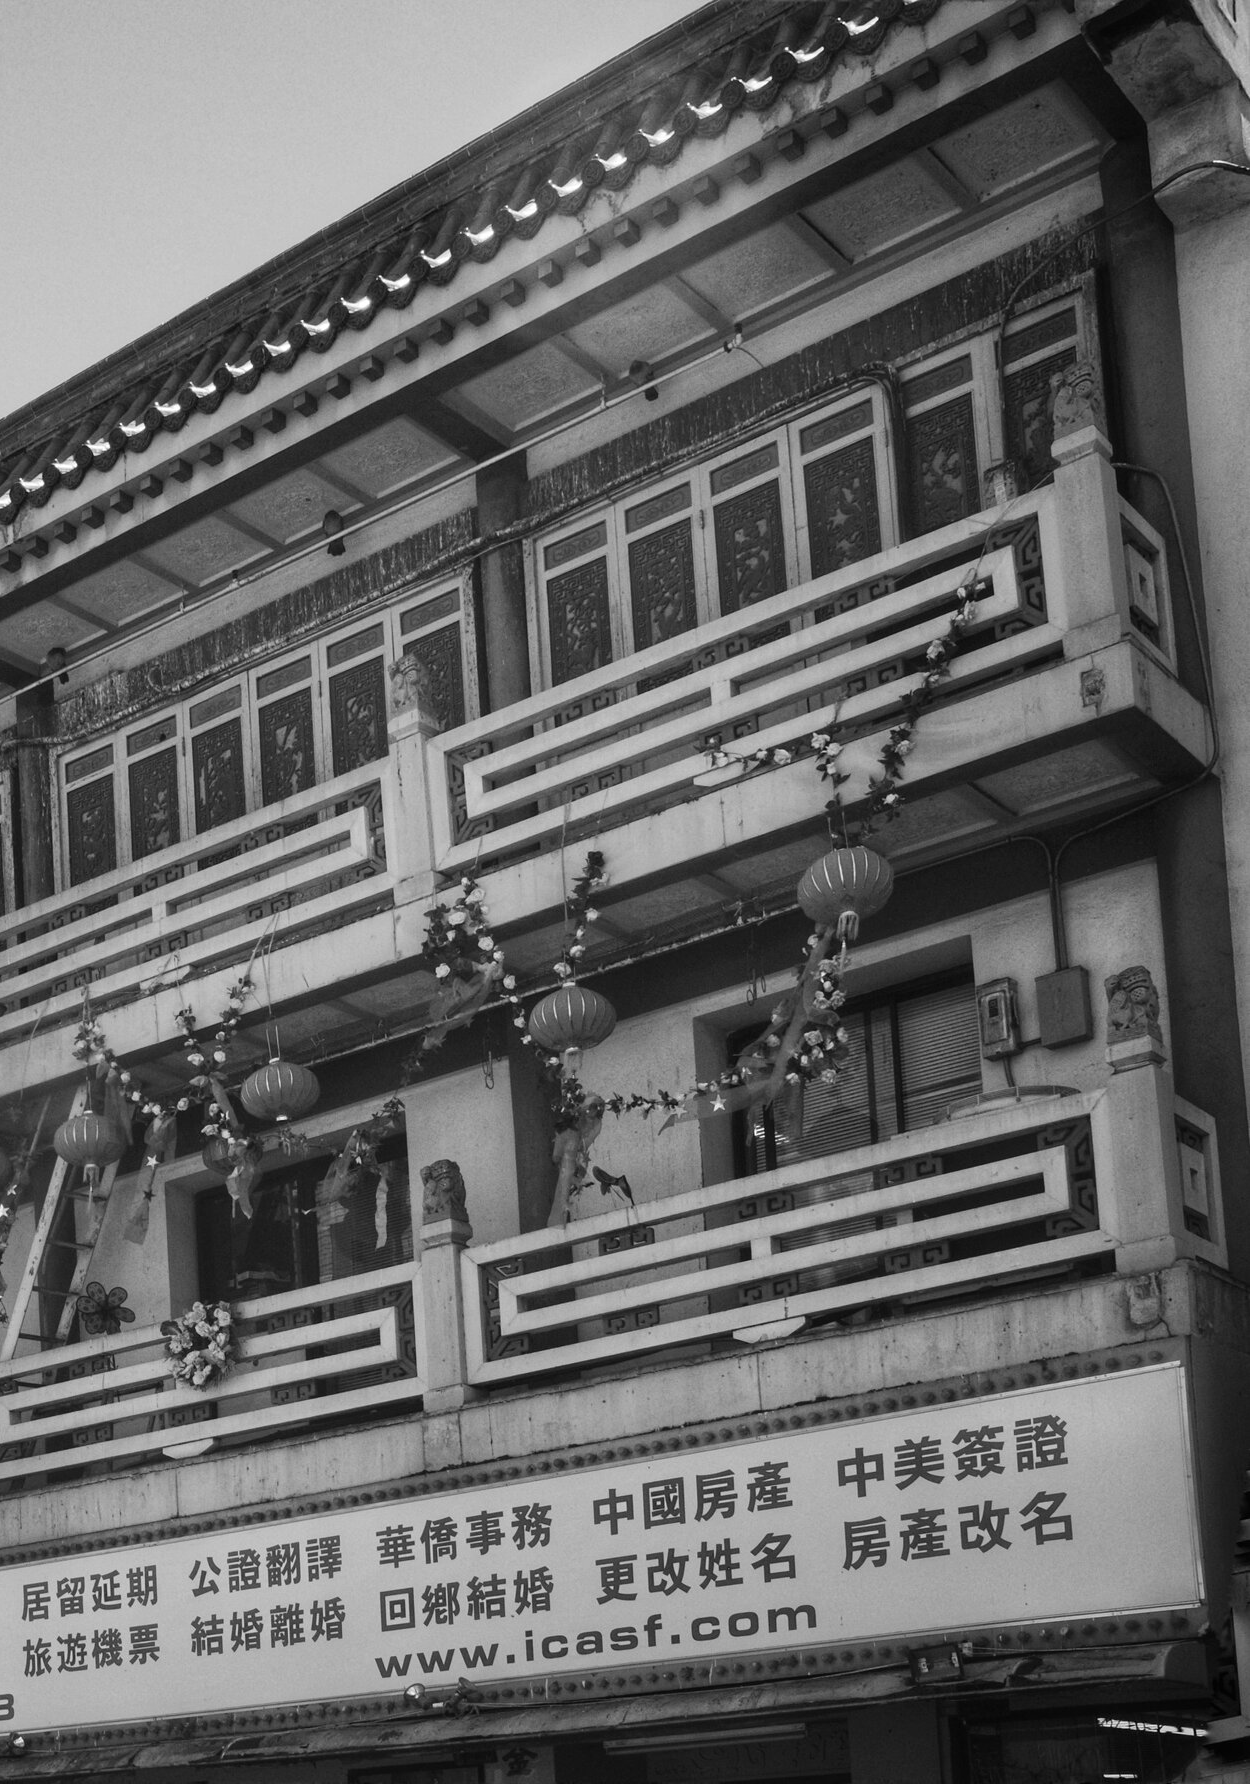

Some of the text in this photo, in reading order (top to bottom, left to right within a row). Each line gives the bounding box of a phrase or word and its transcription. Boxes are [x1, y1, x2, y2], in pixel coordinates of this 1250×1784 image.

[22, 1564, 158, 1621] 居留延期
[189, 1535, 342, 1597] 公證翻譯
[376, 1503, 552, 1568] 華僑事務
[592, 1461, 793, 1535] 中國房產
[837, 1415, 1068, 1497] 中美簽證
[22, 1623, 160, 1677] 旅遊機票
[191, 1597, 346, 1657] 結婚離婚
[380, 1566, 554, 1632] 回鄉結婚
[595, 1532, 796, 1605] 更改姓名
[842, 1491, 1073, 1571] 房產改名
[374, 1602, 817, 1679] www.icasf.com
